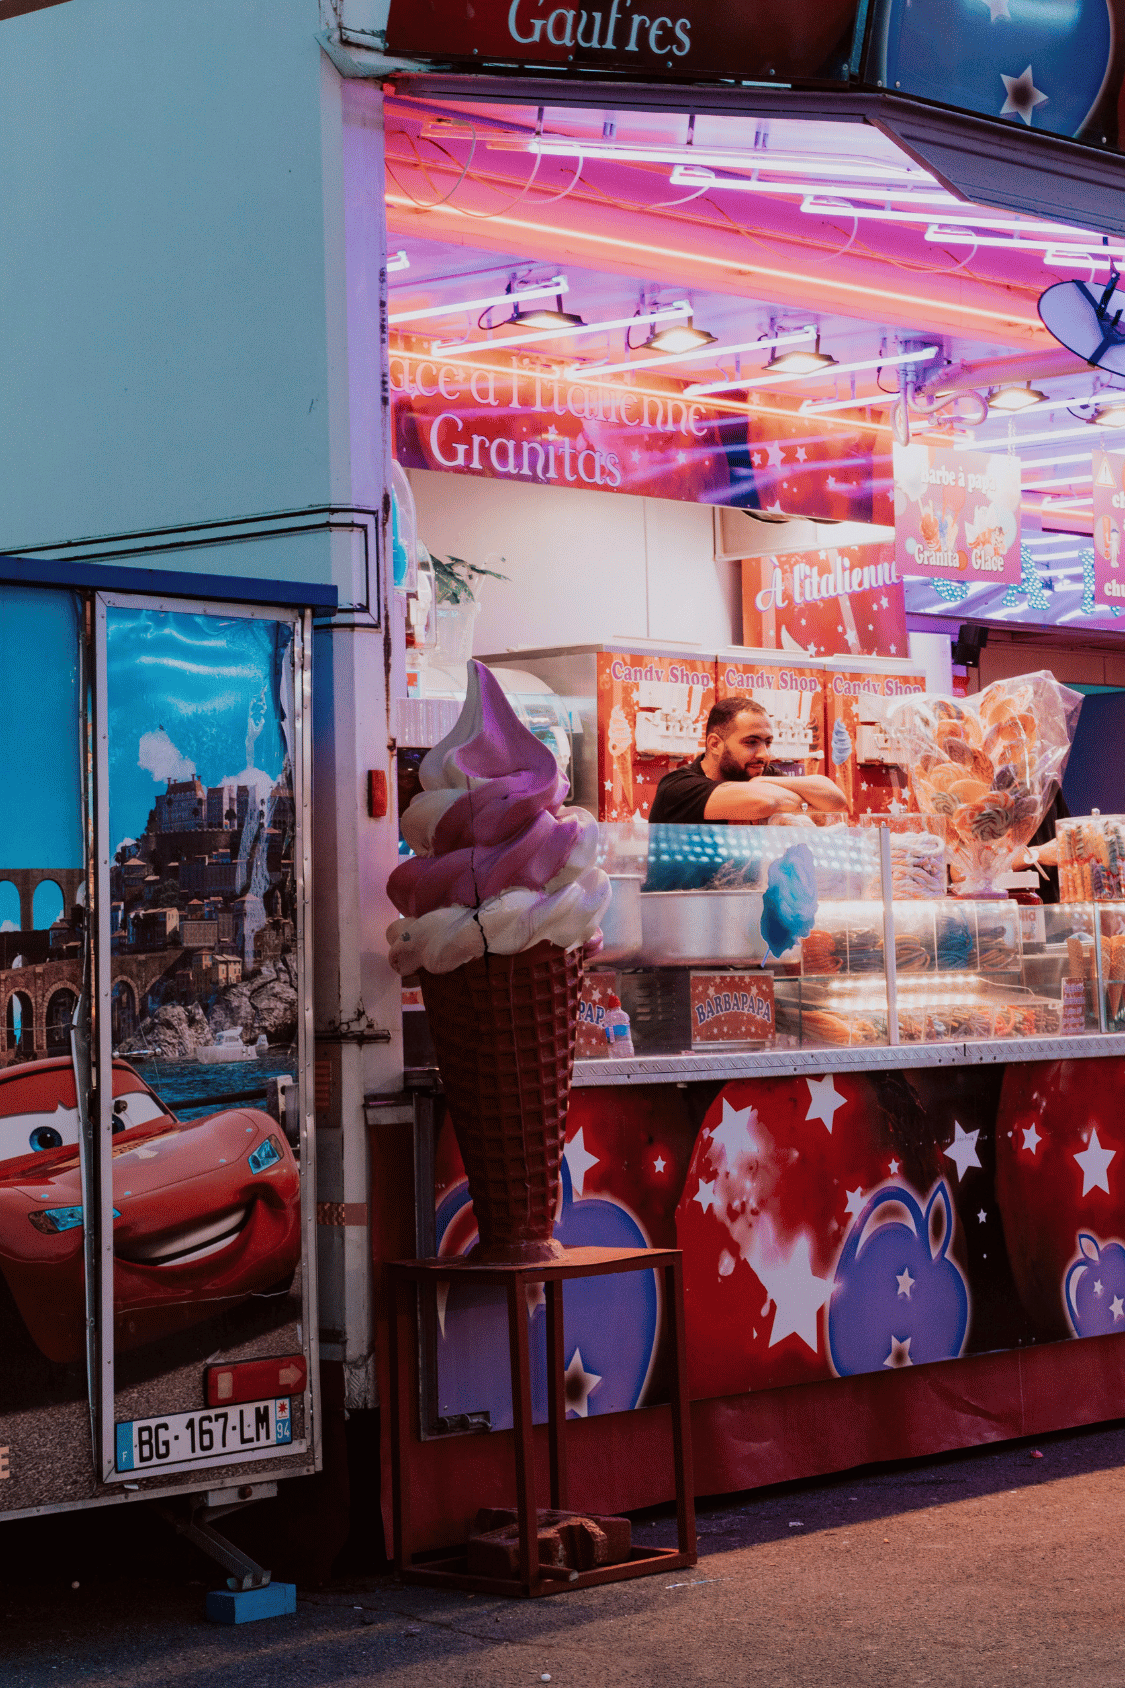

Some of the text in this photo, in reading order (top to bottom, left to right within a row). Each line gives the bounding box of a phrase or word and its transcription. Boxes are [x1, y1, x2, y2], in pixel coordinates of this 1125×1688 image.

[507, 0, 692, 57] Gaufres
[388, 356, 461, 400] ace
[429, 413, 623, 488] Granitas
[958, 466, 966, 488] à
[967, 472, 997, 495] papa
[914, 544, 1005, 572] Granita Glace
[755, 556, 789, 612] À
[793, 555, 903, 606] l'italienn
[611, 660, 711, 692] Candy Shop
[725, 668, 819, 693] Candy Shop
[695, 991, 772, 1025] BARBAPAPA
[122, 1451, 128, 1463] F
[276, 1422, 290, 1440] 94
